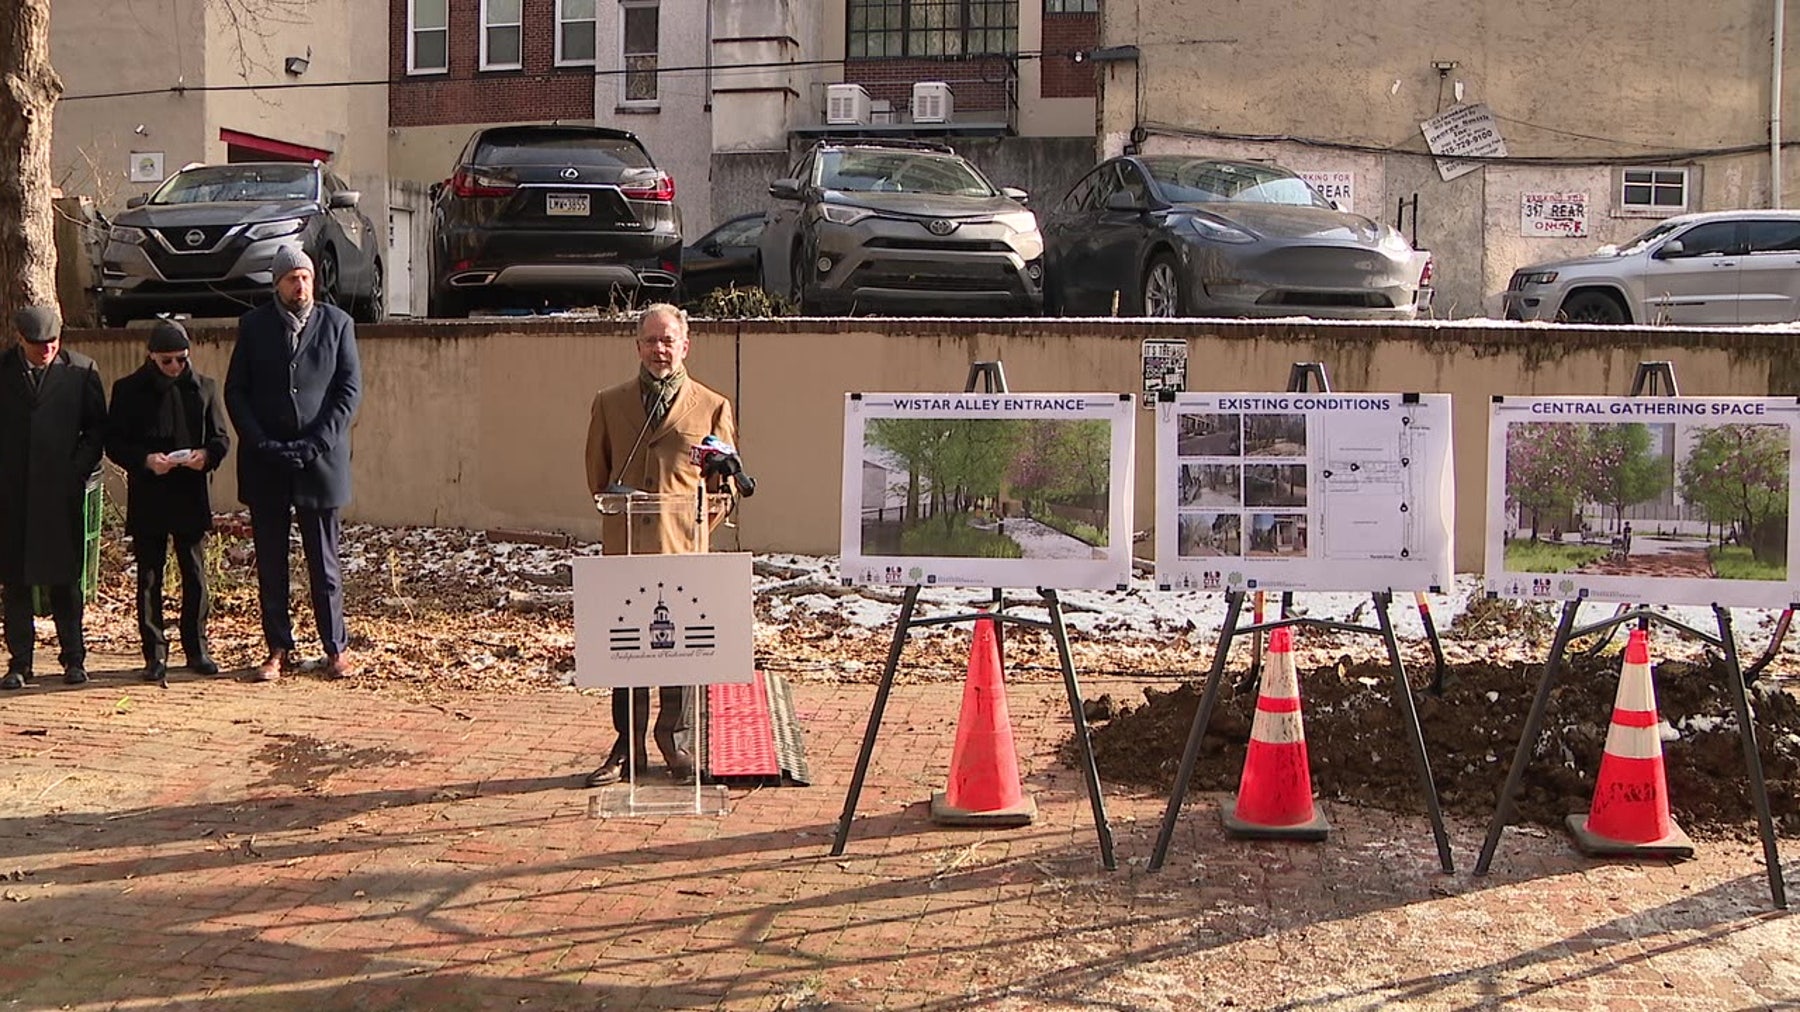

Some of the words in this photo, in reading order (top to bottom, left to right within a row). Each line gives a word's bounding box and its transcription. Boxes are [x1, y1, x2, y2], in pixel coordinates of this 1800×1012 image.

[1317, 184, 1351, 198] REAR
[1551, 204, 1584, 217] REAR
[893, 399, 951, 411] WISTAR
[954, 399, 1000, 411] ALLEY
[1004, 399, 1085, 411] ENTRANCE
[1218, 398, 1289, 410] EXISTING
[1293, 398, 1391, 410] CONDITIONS
[1531, 402, 1605, 414] CENTRAL
[1609, 402, 1707, 415] GATHERING
[1711, 403, 1765, 416] SPACE
